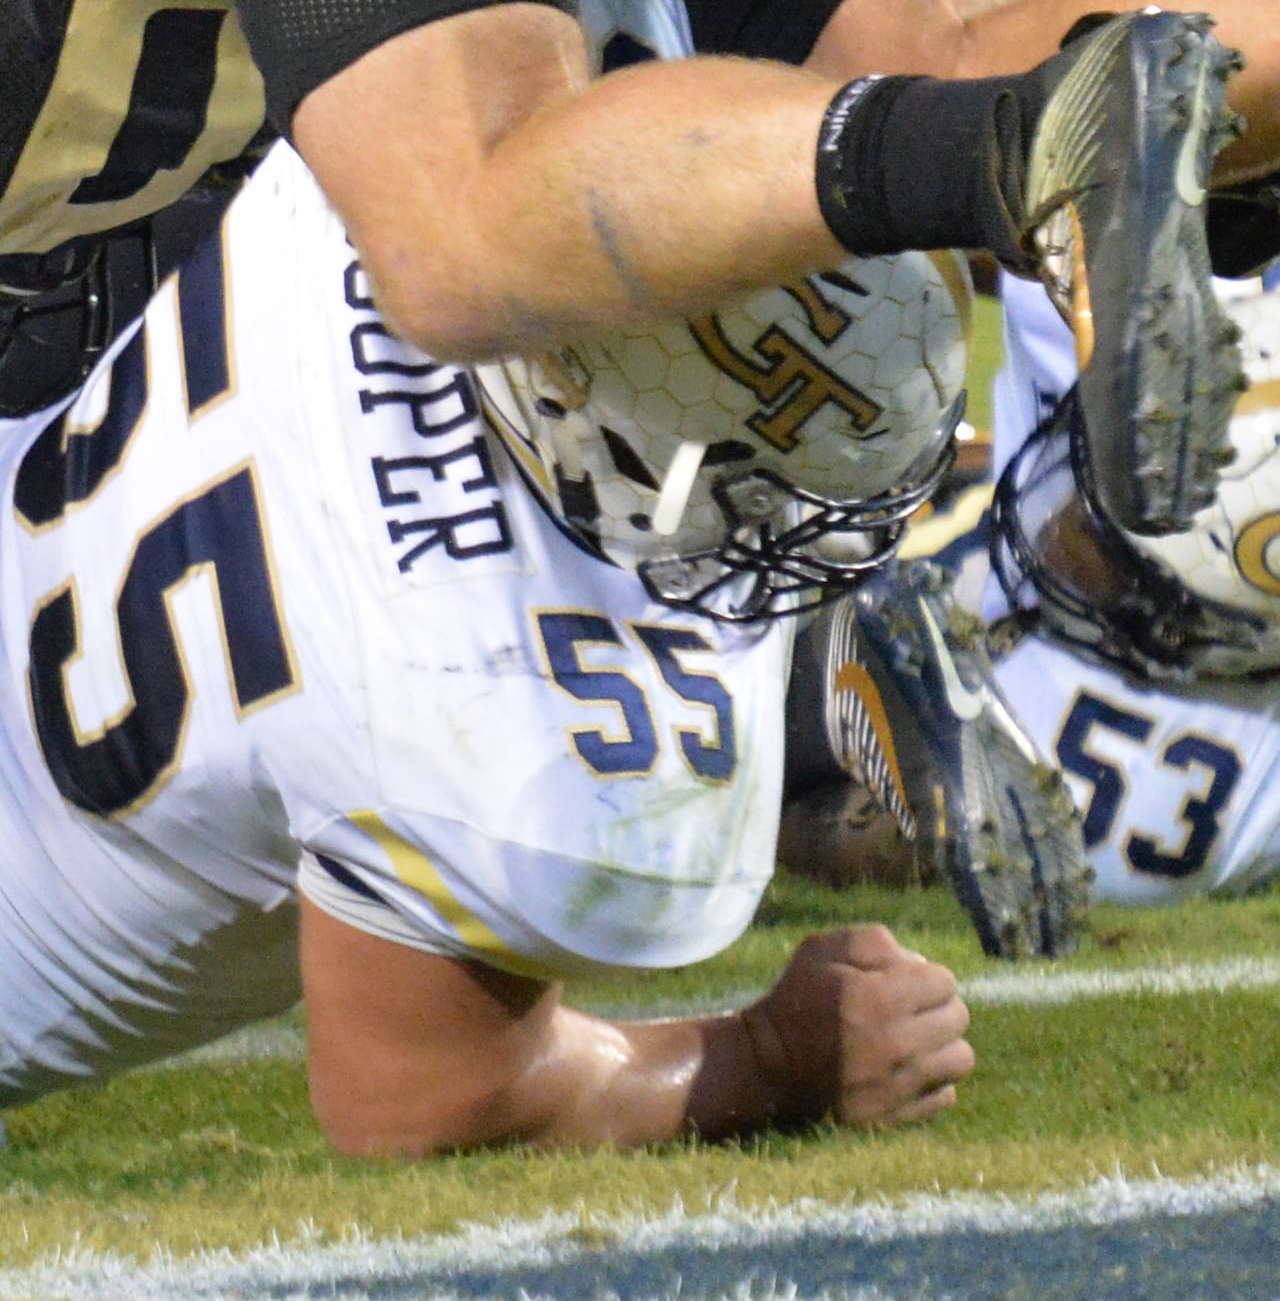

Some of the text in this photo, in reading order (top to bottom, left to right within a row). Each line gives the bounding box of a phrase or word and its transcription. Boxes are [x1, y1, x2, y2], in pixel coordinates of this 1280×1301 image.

[12, 212, 303, 822] 55
[344, 234, 515, 574] OPER
[531, 604, 739, 786] 55
[1052, 684, 1245, 880] 53
